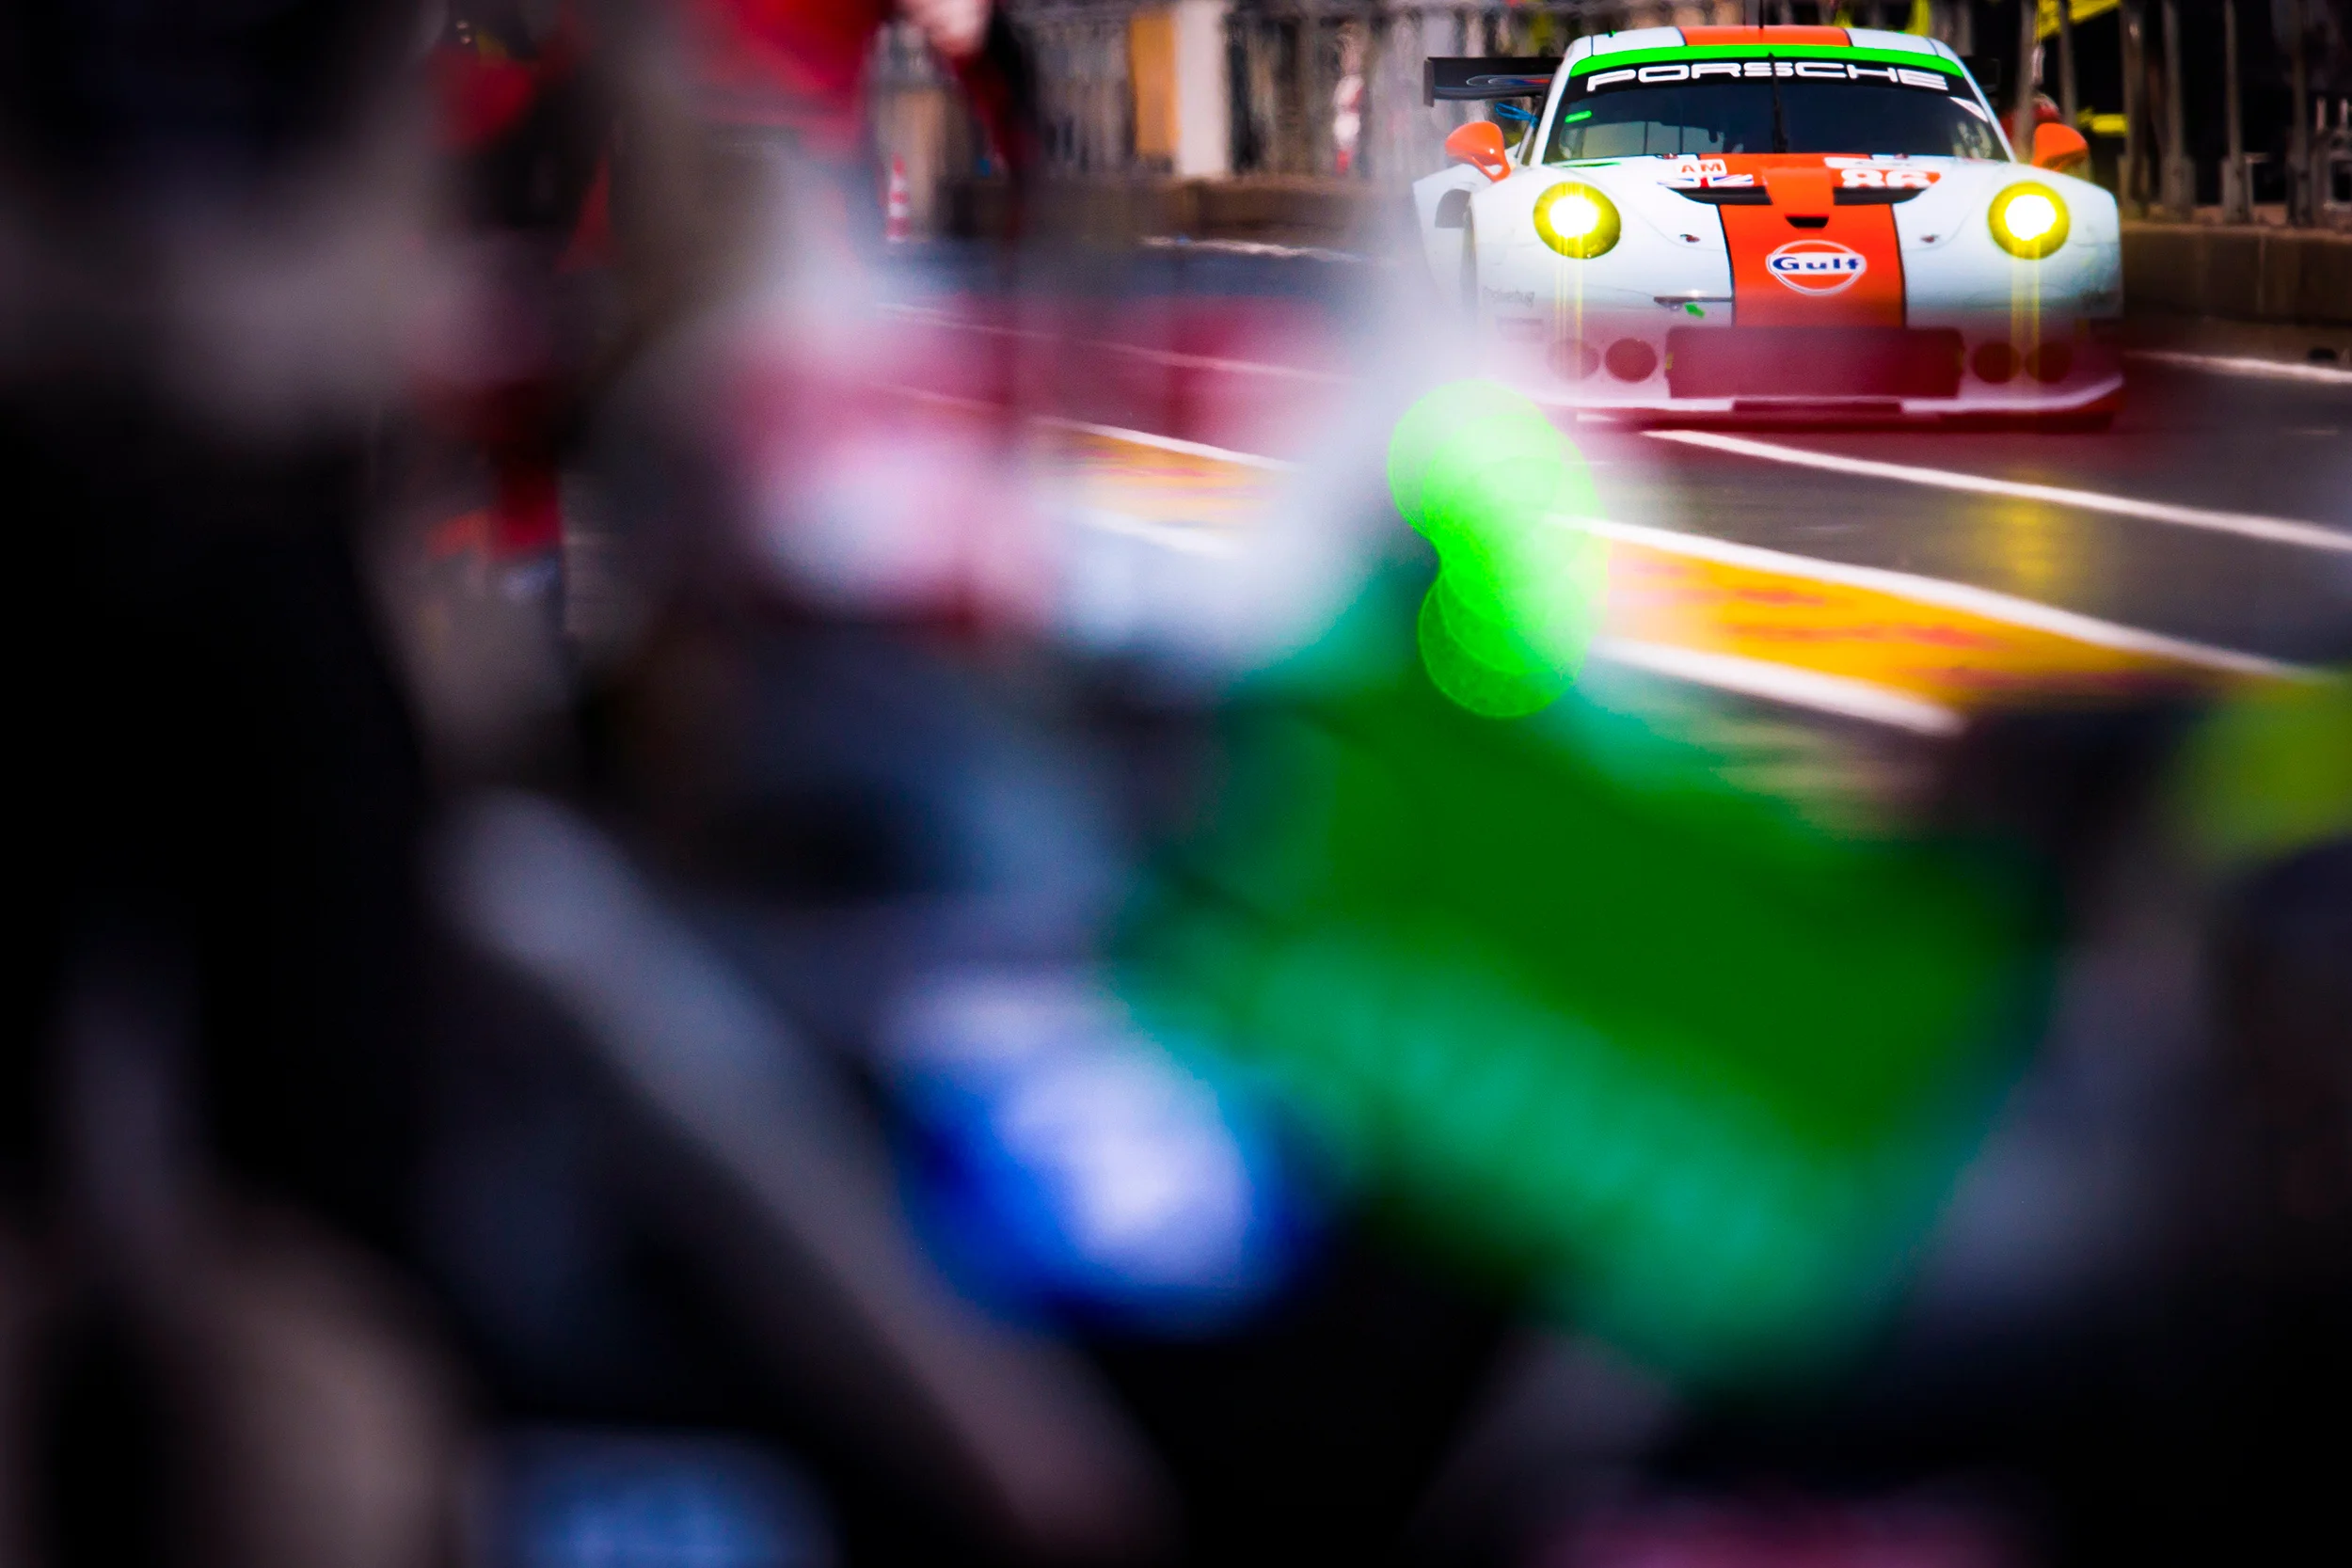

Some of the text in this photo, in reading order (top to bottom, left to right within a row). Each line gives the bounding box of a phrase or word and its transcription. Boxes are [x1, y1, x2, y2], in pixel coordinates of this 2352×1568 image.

[1586, 61, 1948, 91] PORSCHE
[1681, 163, 1723, 173] AM
[1772, 256, 1859, 270] Gulf
